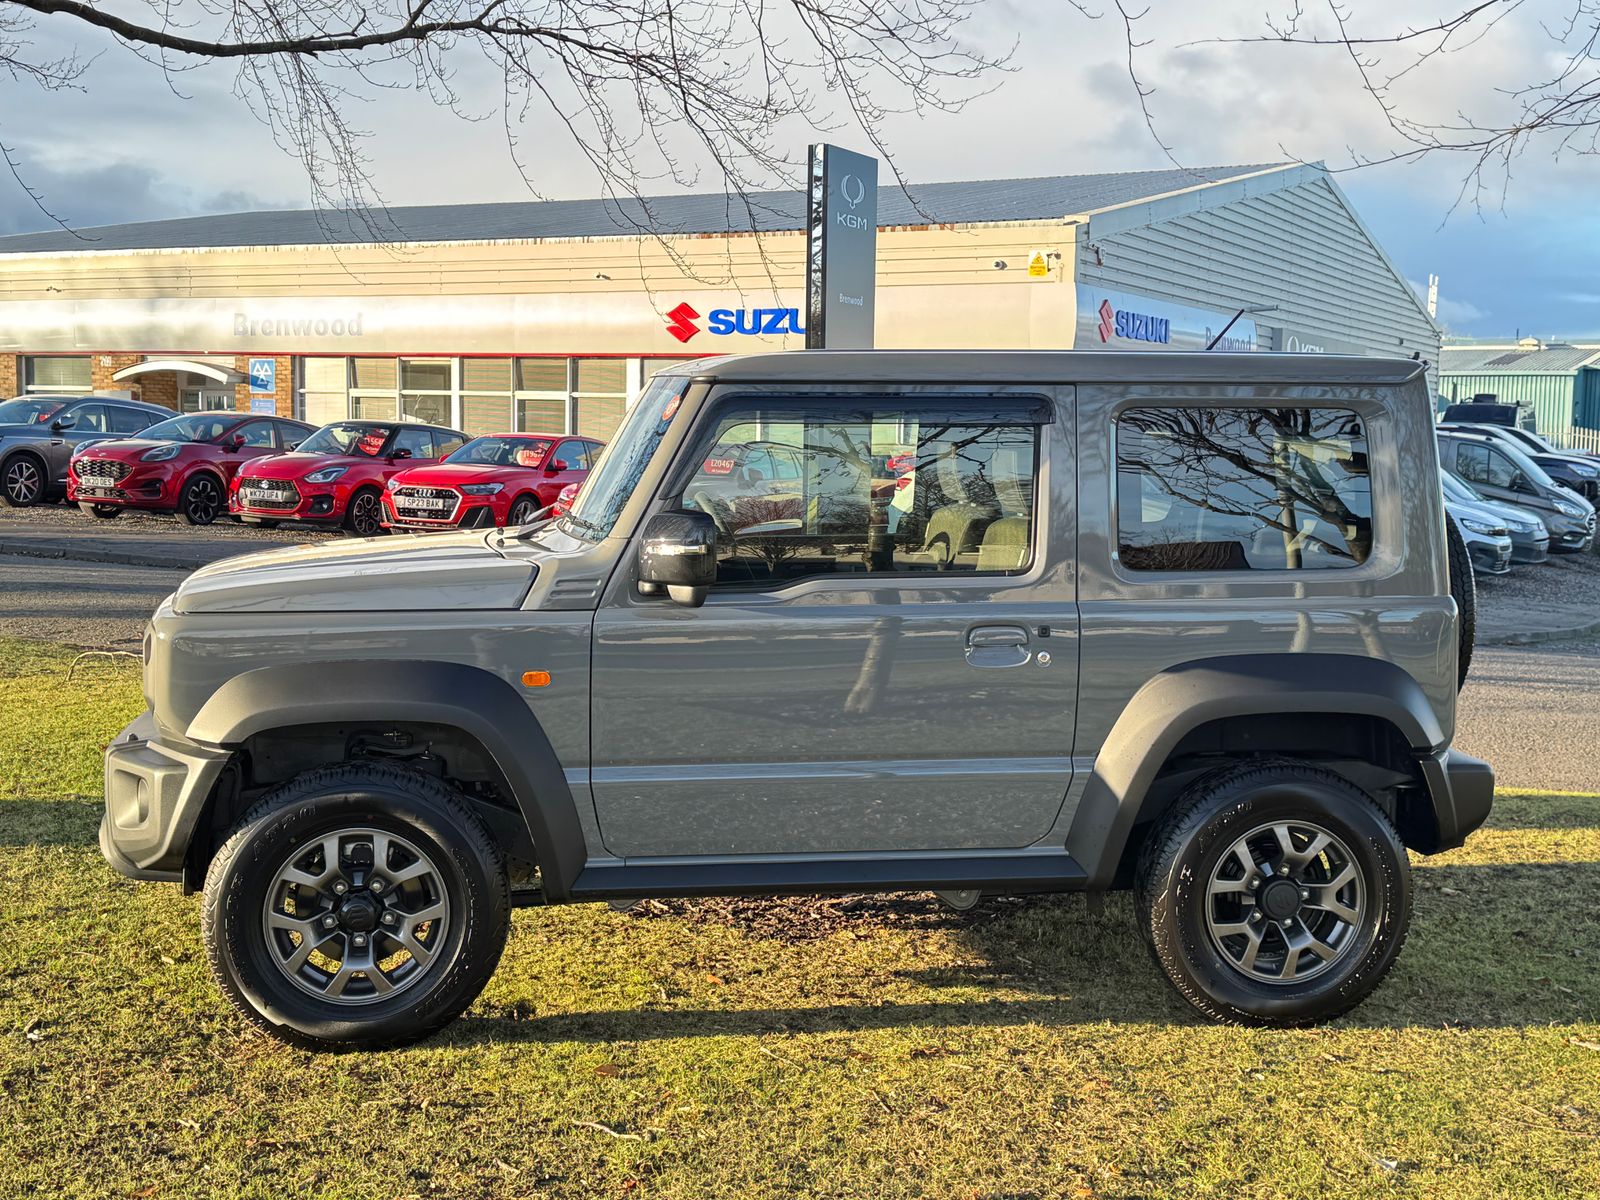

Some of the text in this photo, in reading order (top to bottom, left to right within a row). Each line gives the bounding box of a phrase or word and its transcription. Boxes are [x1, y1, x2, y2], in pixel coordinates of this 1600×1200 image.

[836, 211, 867, 231] KGM
[233, 311, 364, 337] Brenwood
[1115, 309, 1169, 344] SUZUKI
[407, 498, 440, 508] SP23 BAK
